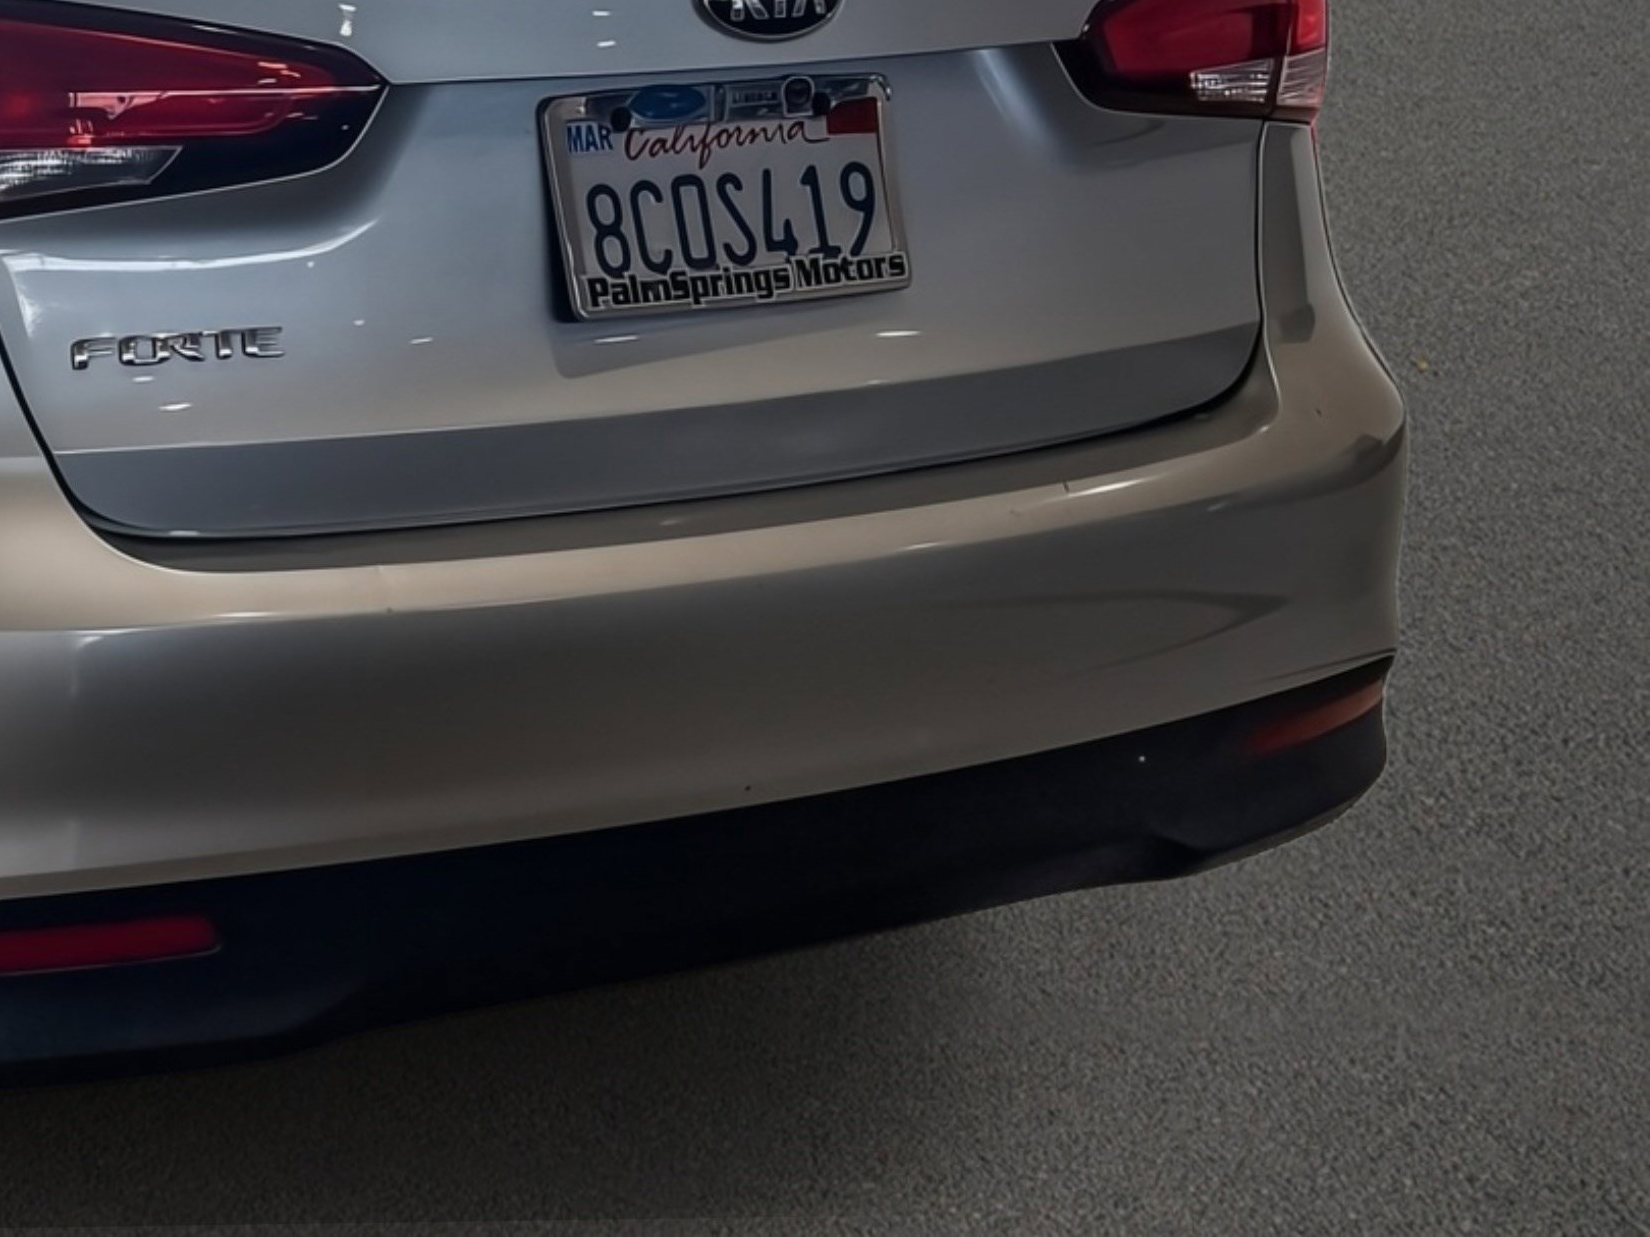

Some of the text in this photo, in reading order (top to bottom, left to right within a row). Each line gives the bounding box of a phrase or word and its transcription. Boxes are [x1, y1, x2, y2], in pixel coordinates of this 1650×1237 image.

[566, 120, 829, 169] MAR California
[587, 252, 907, 308] PalmSprings Motors
[70, 326, 284, 371] FORTE
